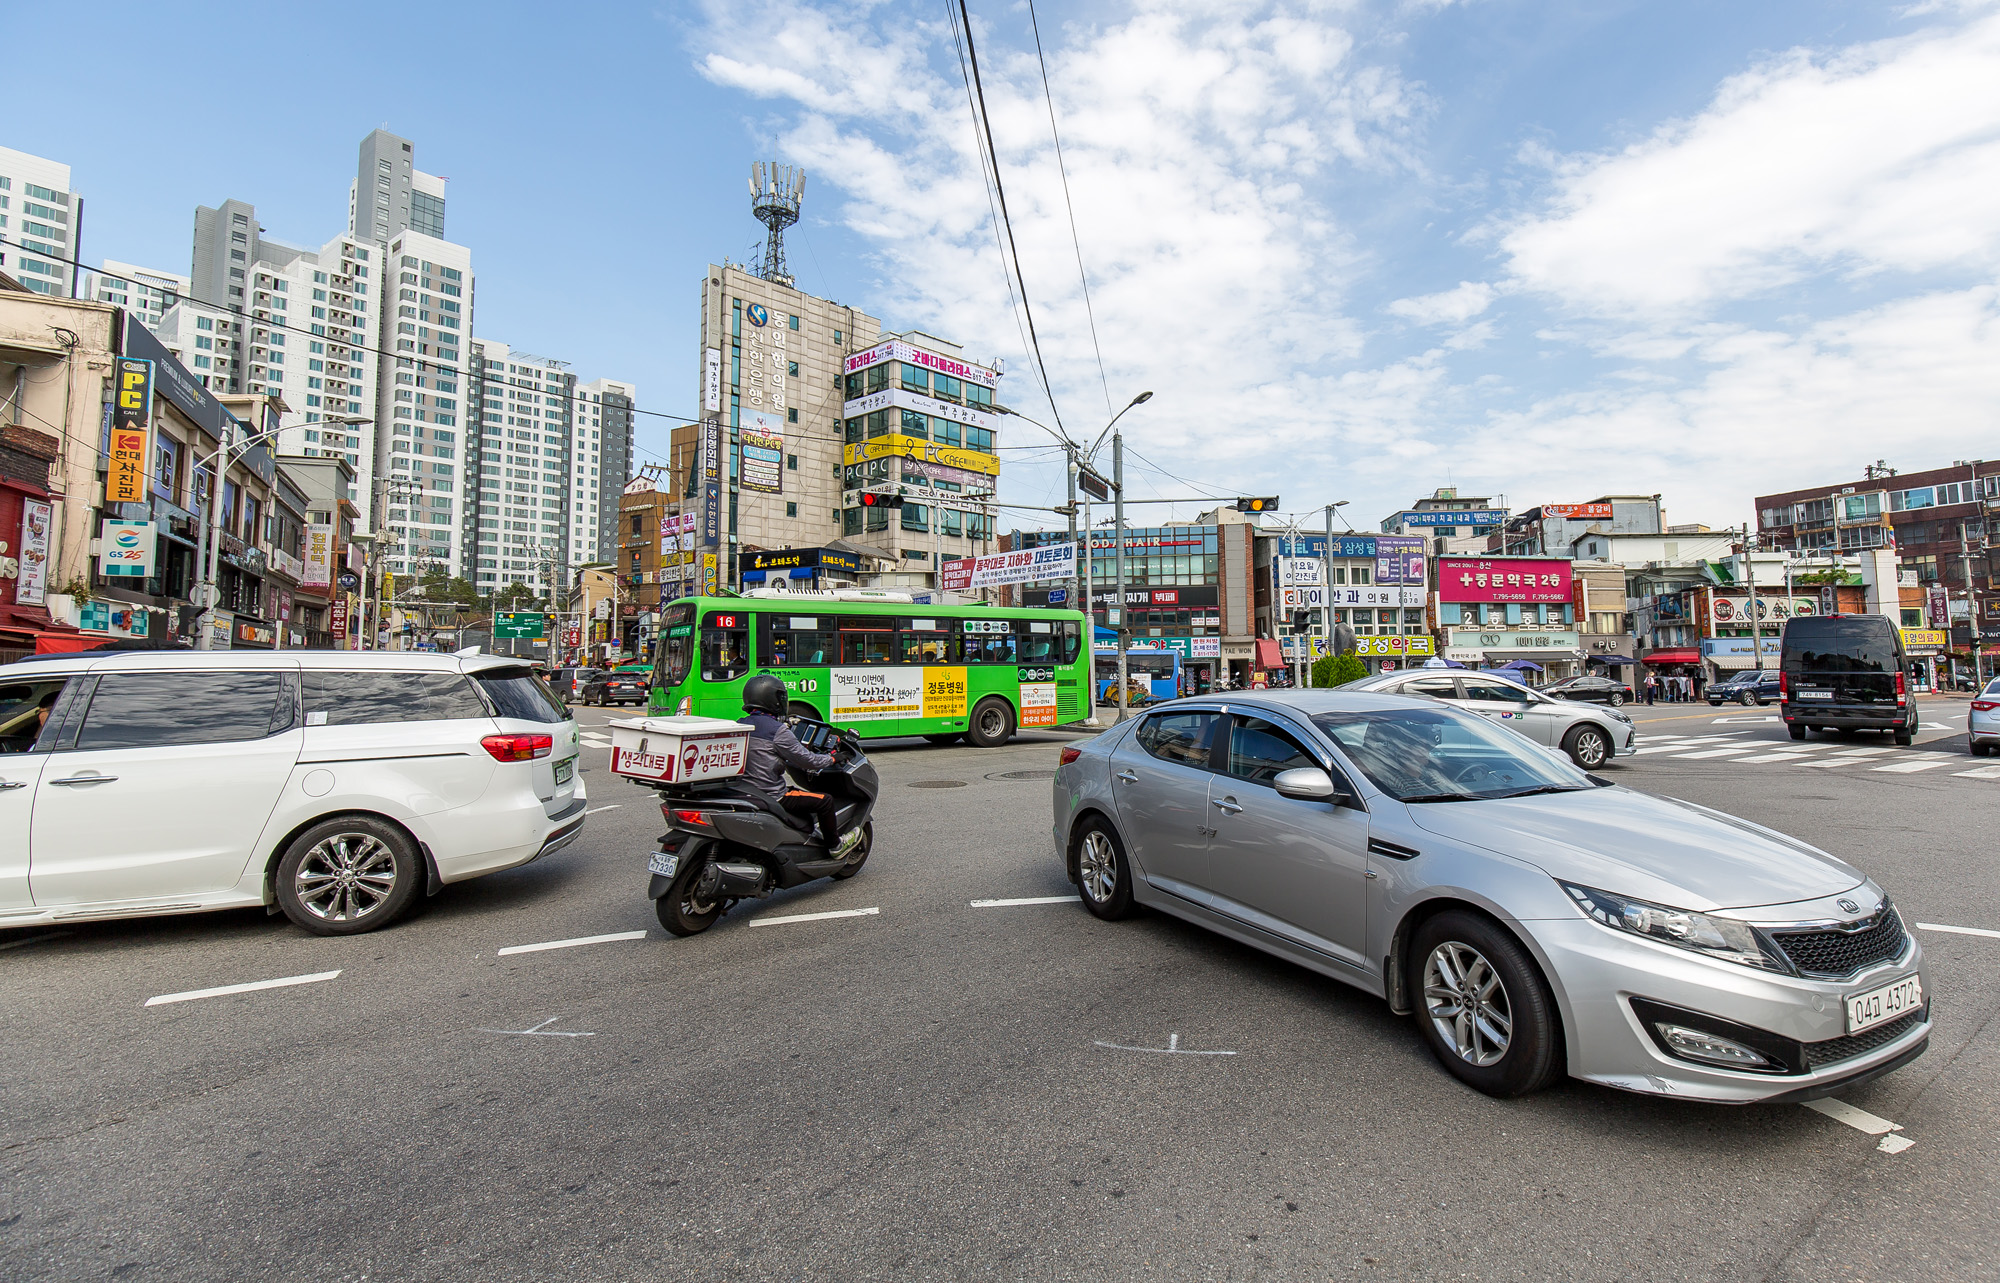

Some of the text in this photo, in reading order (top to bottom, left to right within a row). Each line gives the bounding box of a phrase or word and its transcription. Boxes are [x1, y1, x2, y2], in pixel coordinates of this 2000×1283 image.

[771, 310, 786, 411] 동인한의원
[912, 349, 972, 379] 굿바디필라테스
[749, 331, 764, 406] 신한은행
[115, 450, 142, 461] 현대
[853, 440, 869, 463] PC
[924, 441, 944, 463] PC
[944, 453, 964, 468] CAFE
[706, 468, 718, 478] 3F
[117, 462, 138, 500] 사진관
[708, 501, 716, 538] 신한은행
[310, 532, 326, 565] 컴퓨터
[1125, 537, 1161, 548] HAIR
[109, 550, 145, 561] GS25
[769, 555, 800, 567] 브레드덕
[821, 555, 845, 567] 브레드덕
[976, 546, 1073, 572] 동작대로 지하화 대토론회
[1367, 592, 1389, 604] 의원
[719, 617, 733, 627] 16
[1515, 636, 1533, 646] 1001
[799, 677, 818, 693] 10
[861, 674, 885, 685] 이번에
[928, 681, 964, 695] 정동병원
[1023, 716, 1040, 724] 한우리
[620, 750, 666, 771] 생각대로
[698, 751, 740, 773] 생각대로
[655, 862, 674, 874] 7330
[1886, 981, 1915, 1013] 4372
